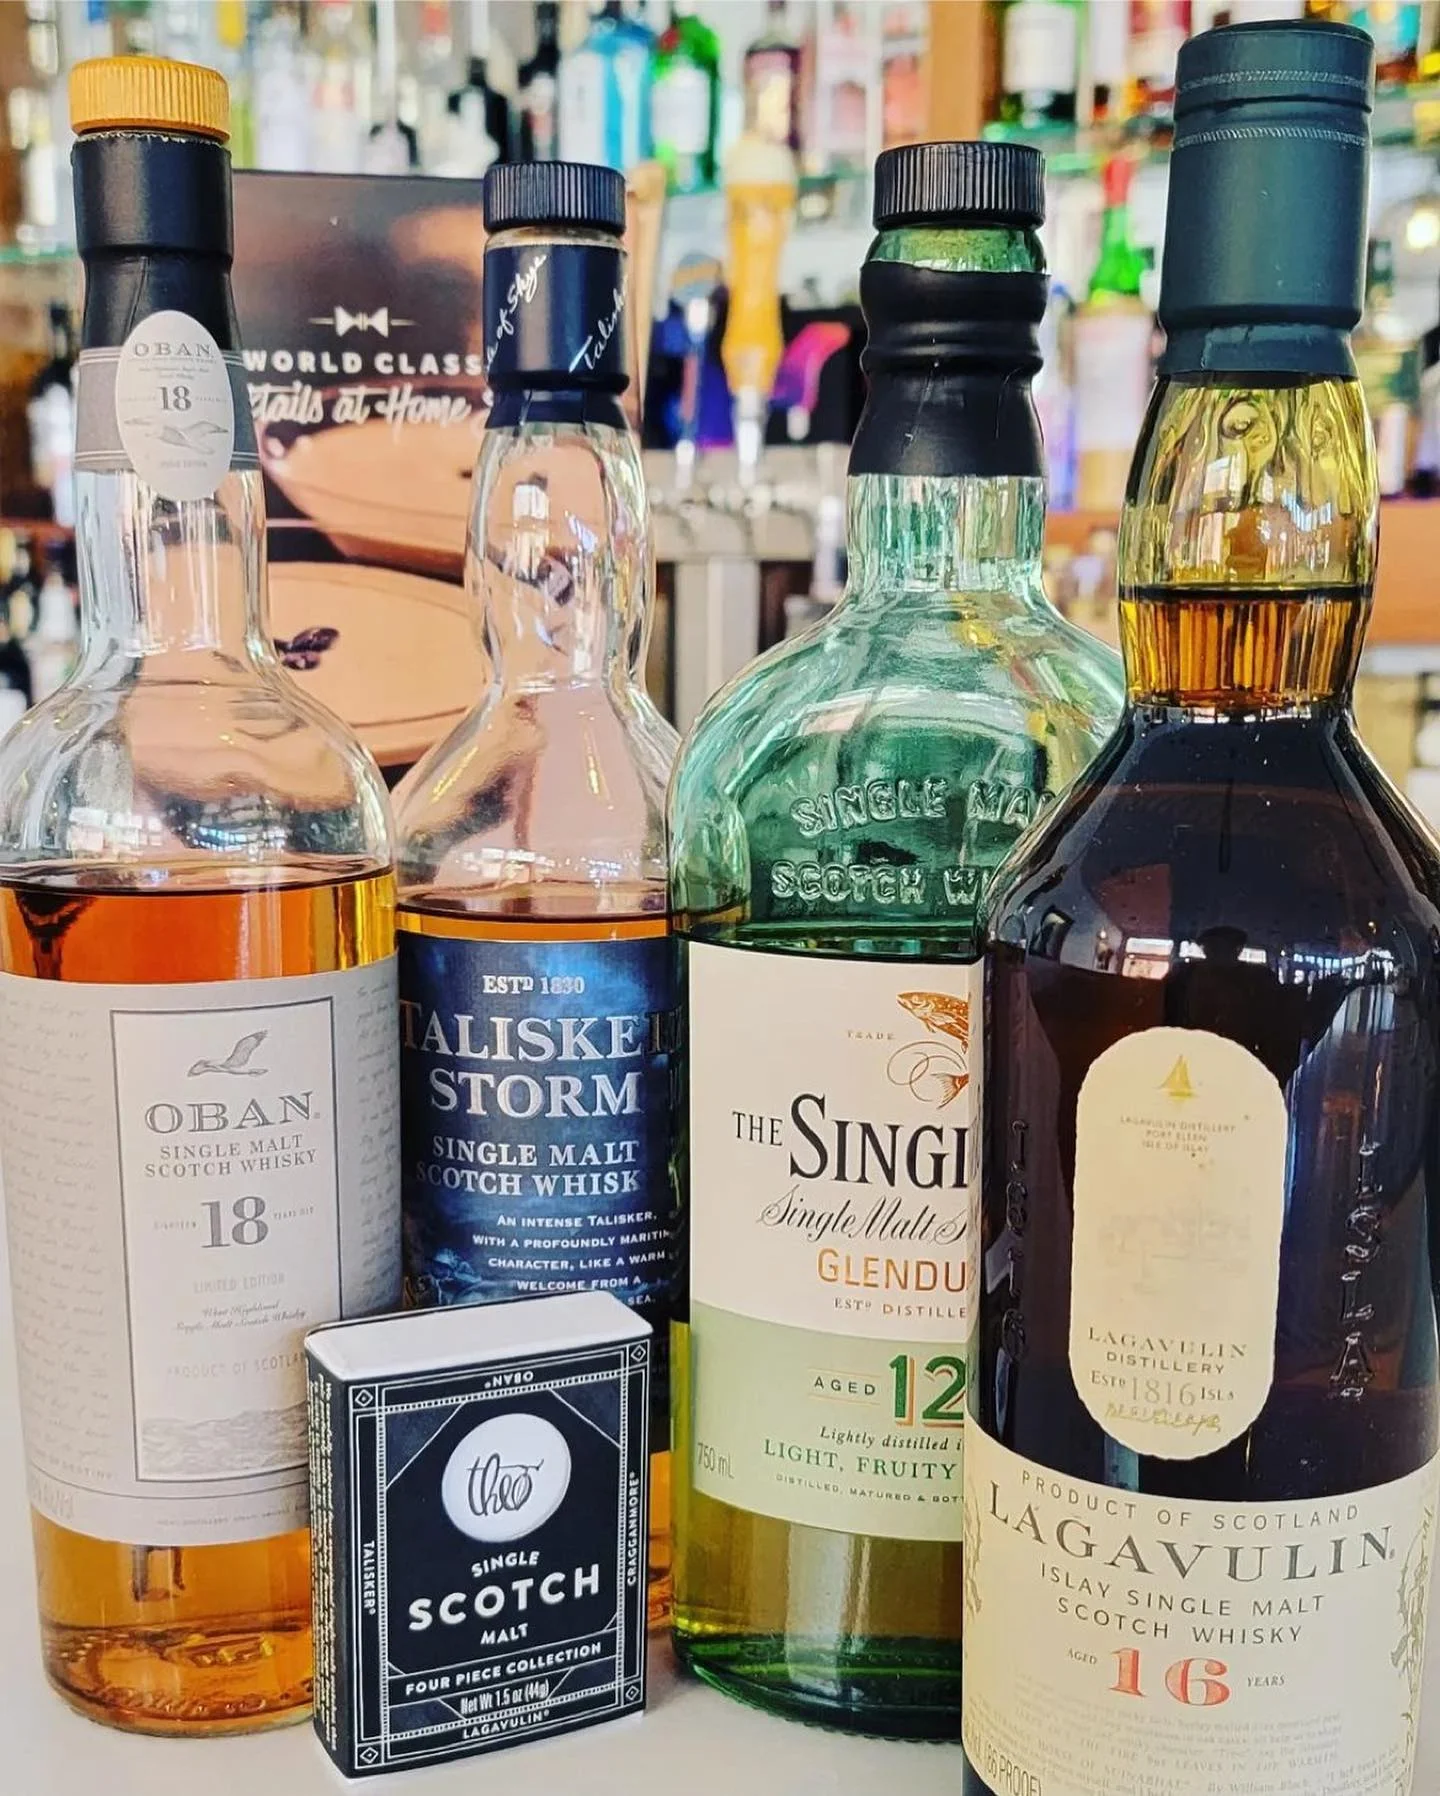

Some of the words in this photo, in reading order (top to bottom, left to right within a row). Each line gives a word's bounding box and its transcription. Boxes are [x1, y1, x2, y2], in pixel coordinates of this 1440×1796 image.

[507, 254, 547, 314] Skye
[134, 341, 211, 358] OBAN
[243, 350, 363, 374] WORLD
[374, 352, 484, 376] CLASS
[159, 385, 192, 411] 18
[332, 385, 388, 424] at
[374, 381, 473, 430] Home
[789, 776, 949, 839] SINGLE
[770, 859, 926, 905] SCOTCH
[540, 975, 586, 995] 1830
[429, 1067, 644, 1119] STORM
[144, 1090, 314, 1135] OBAN
[731, 1110, 784, 1147] THE
[144, 1160, 232, 1179] SCOTCH
[240, 1149, 317, 1174] WHISKY
[160, 1141, 241, 1161] SINGLE
[249, 1133, 304, 1154] MALT
[432, 1134, 538, 1167] SINGLE
[549, 1139, 640, 1167] MALT
[415, 1160, 522, 1196] SCOTCH
[201, 1196, 269, 1249] 18
[497, 1214, 516, 1227] AN
[521, 1216, 583, 1229] INTENSE
[587, 1210, 657, 1227] TALISKER,
[756, 1183, 856, 1243] Single
[849, 1195, 939, 1243] Malt
[472, 1233, 505, 1248] WITH
[510, 1238, 520, 1248] A
[524, 1236, 616, 1250] PROFOUNDLY
[487, 1257, 575, 1272] CHARACTER,
[579, 1257, 612, 1270] LIKE
[615, 1256, 625, 1267] A
[629, 1250, 666, 1265] WARM
[516, 1279, 587, 1292] WELCOME
[591, 1276, 629, 1290] FROM
[632, 1275, 642, 1286] A
[1088, 1326, 1249, 1359] LAGAVULIN
[492, 1370, 535, 1388] OBAN
[1105, 1351, 1226, 1375] DISTILLERY
[813, 1375, 877, 1397] AGED
[1131, 1376, 1197, 1407] 1816
[819, 1425, 876, 1450] Lightly
[881, 1431, 950, 1451] distilled
[696, 1441, 716, 1476] 750
[763, 1438, 845, 1473] LIGHT,
[856, 1455, 960, 1481] FRUITY
[466, 1452, 545, 1518] theo
[776, 1473, 844, 1496] DISTILLED,
[849, 1488, 913, 1502] MATURED
[1021, 1470, 1137, 1521] PRODUCT
[1157, 1508, 1193, 1528] OF
[1213, 1504, 1360, 1532] SCOTLAND
[627, 1478, 640, 1587] CRAGGANMORE
[988, 1480, 1393, 1583] LAGAVULIN
[363, 1540, 376, 1610] TALISKER
[470, 1550, 540, 1578] SINGLE
[408, 1563, 600, 1632] SCOTCH
[1040, 1562, 1112, 1601] ISLAY
[1127, 1588, 1232, 1618] SINGLE
[1252, 1594, 1326, 1617] MALT
[480, 1622, 529, 1646] MALT
[1057, 1596, 1169, 1640] SCOTCH
[1192, 1625, 1305, 1645] WHISKY
[405, 1672, 451, 1696] FOUR
[455, 1662, 502, 1687] PIECE
[506, 1641, 602, 1676] COLLECTION
[1066, 1648, 1098, 1666] AGED
[1108, 1646, 1232, 1707] 16
[1246, 1674, 1286, 1689] YEARS
[460, 1696, 478, 1715] Net
[479, 1692, 493, 1711] Wt
[495, 1688, 511, 1707] 1.5
[512, 1688, 524, 1704] oz
[524, 1678, 550, 1703] (44g)
[462, 1711, 543, 1740] LAGAVULIN
